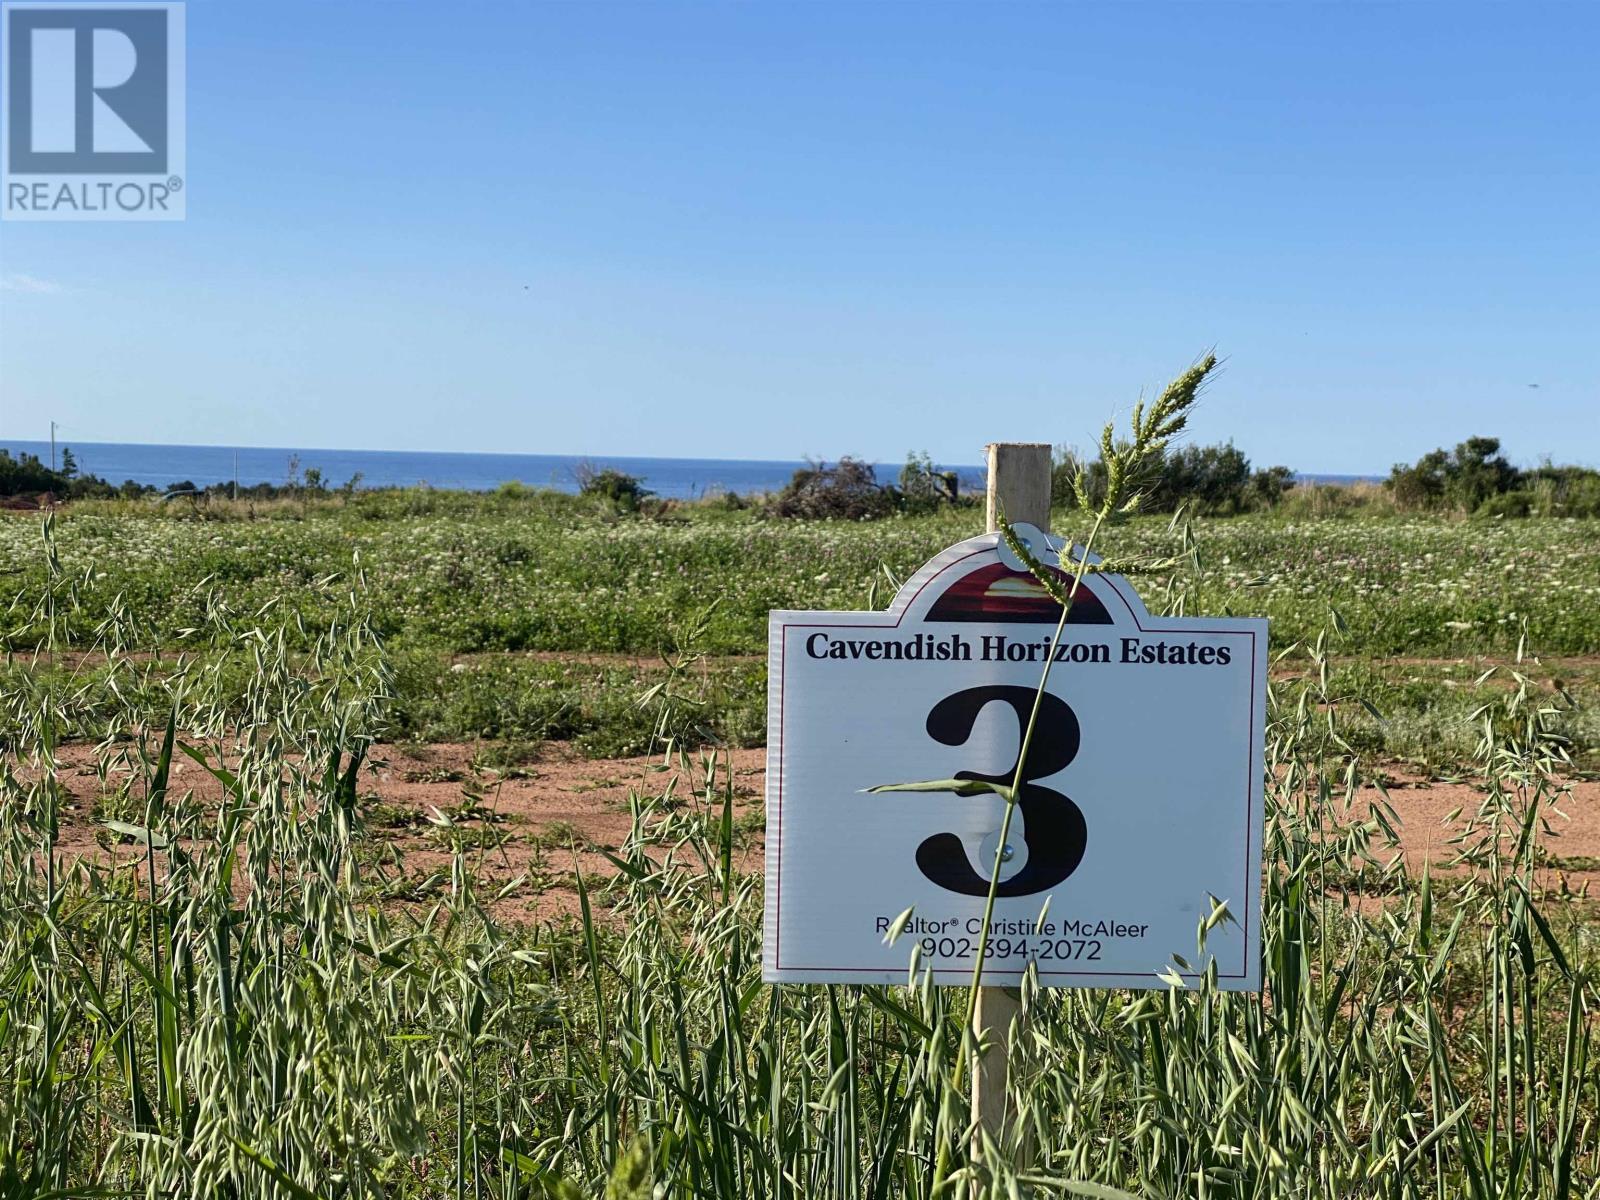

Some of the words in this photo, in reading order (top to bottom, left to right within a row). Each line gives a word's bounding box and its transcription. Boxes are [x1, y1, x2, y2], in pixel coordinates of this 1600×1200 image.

[806, 632, 971, 661] Cavendish
[980, 635, 1111, 663] Horizon
[1119, 637, 1232, 665] Estates
[915, 684, 1088, 898] 3
[876, 916, 959, 934] Raltor®
[1063, 920, 1149, 938] McAleer
[921, 937, 1102, 960] 902-394-2072
